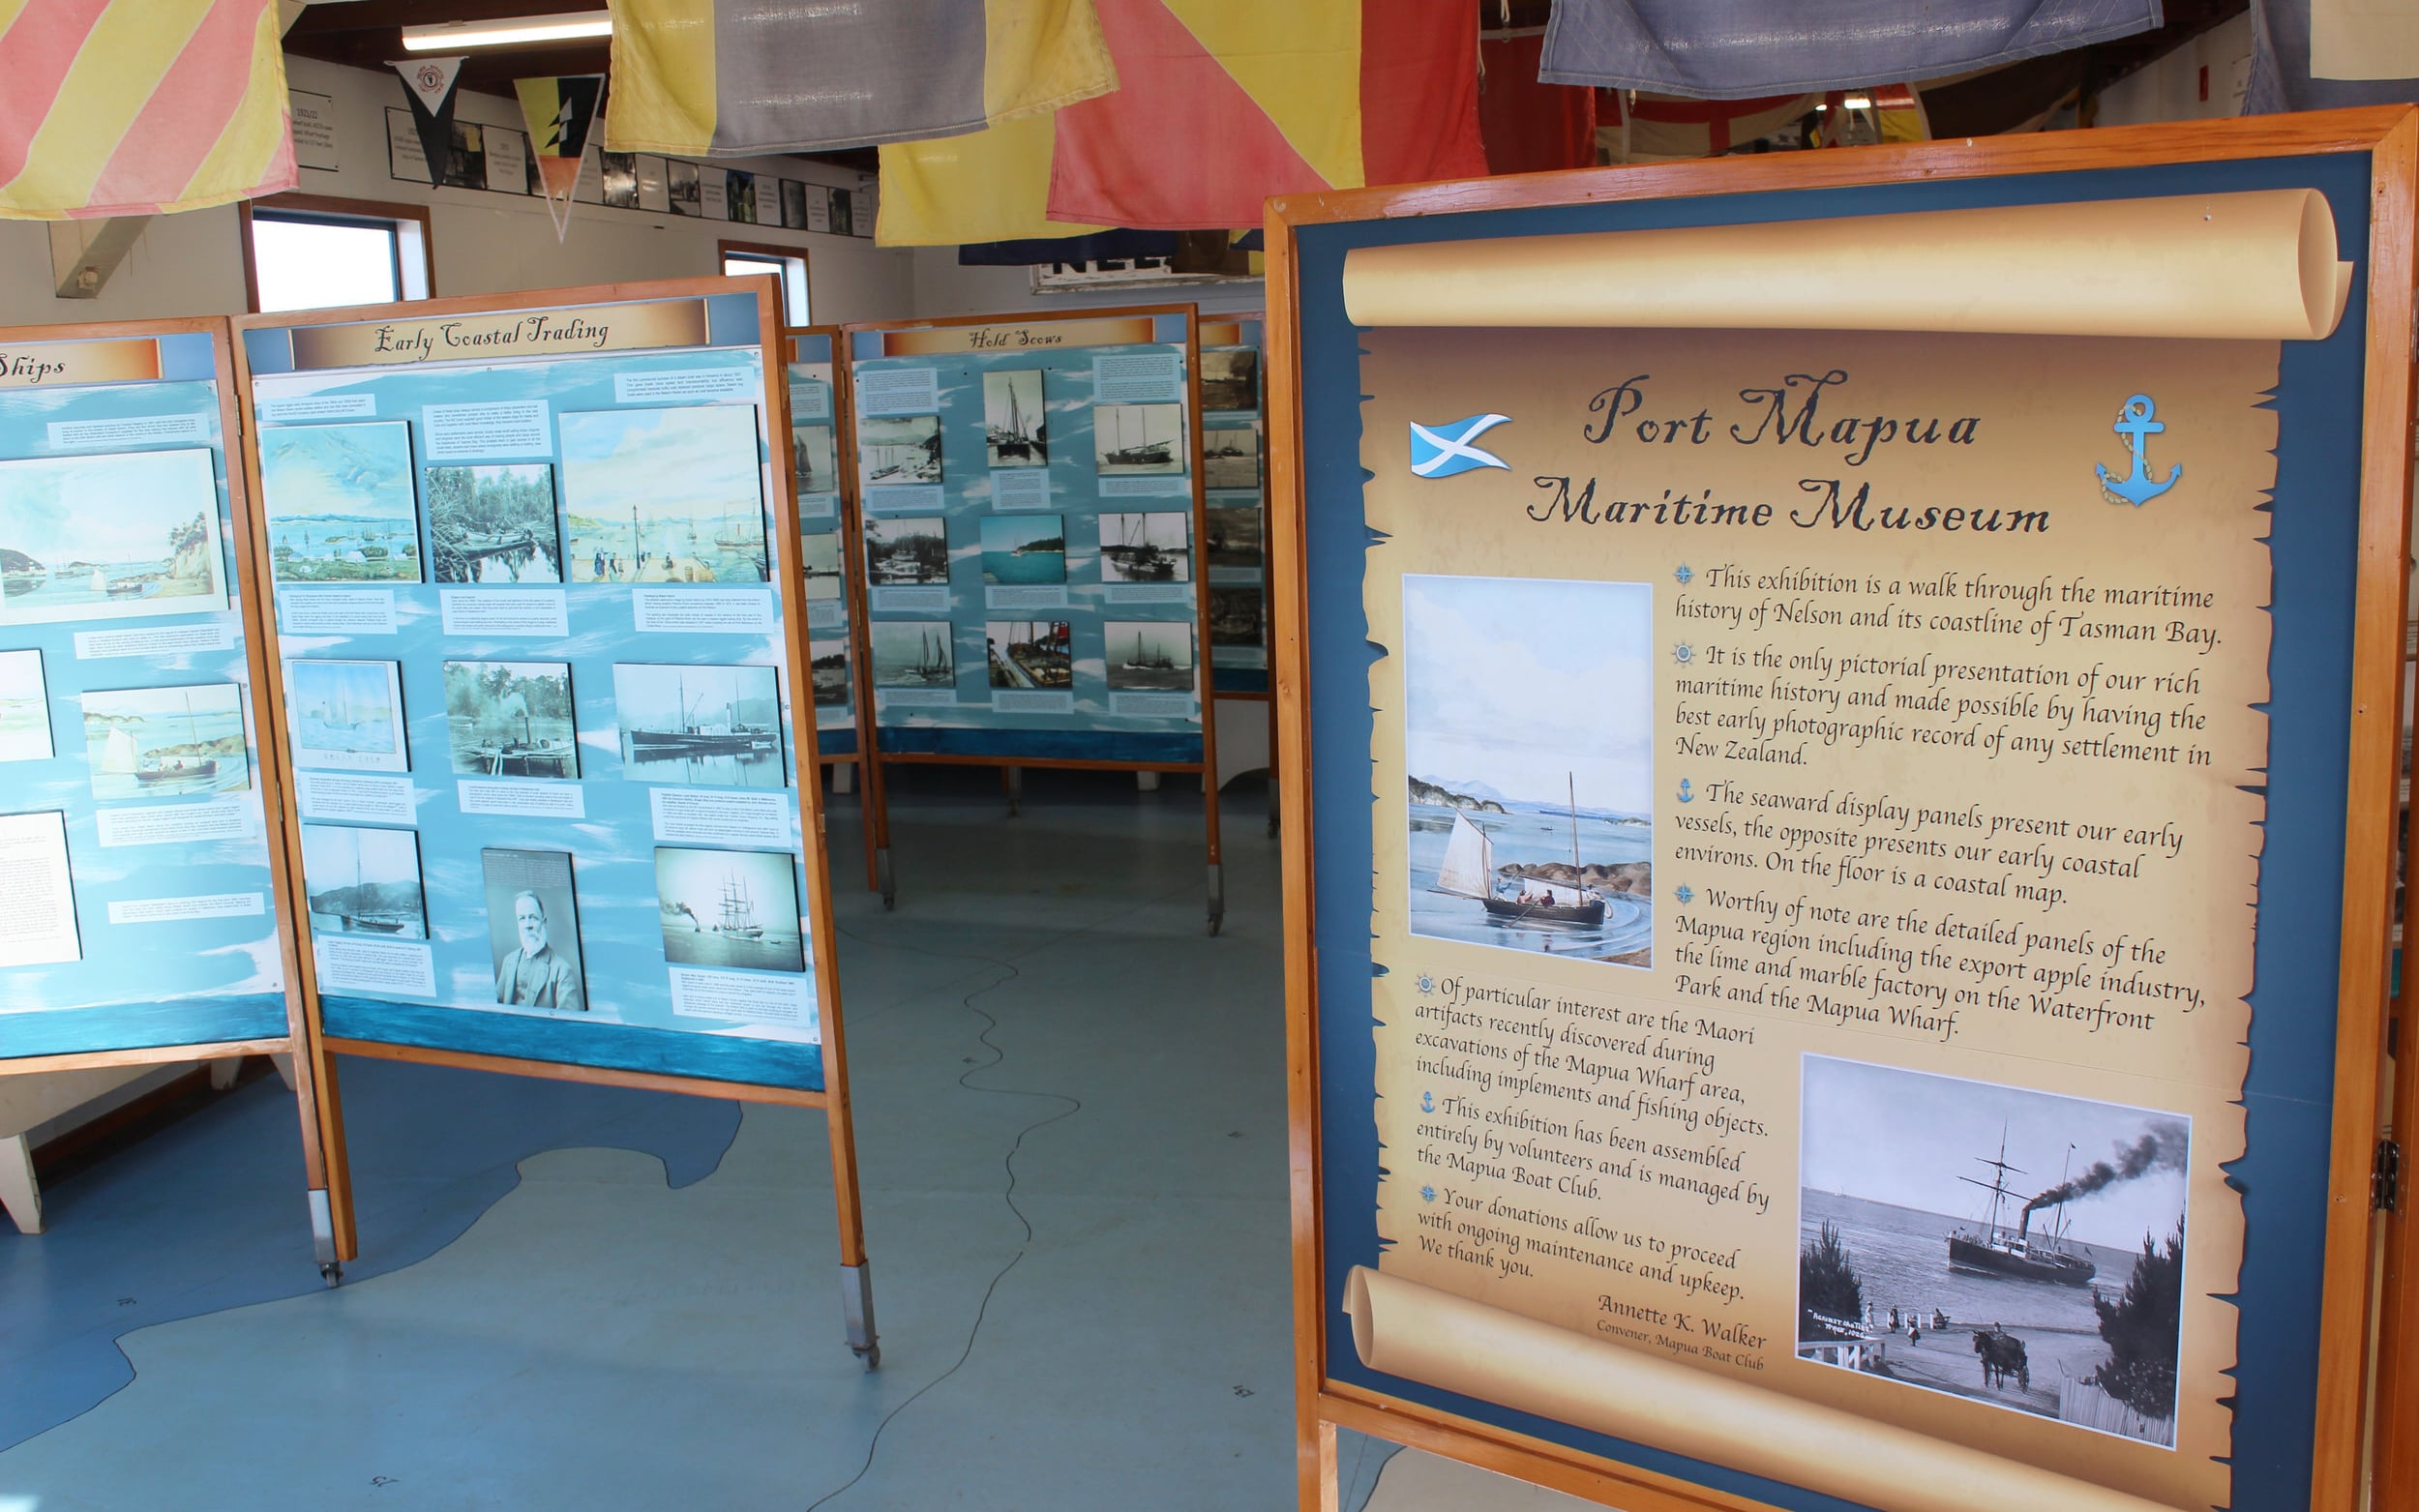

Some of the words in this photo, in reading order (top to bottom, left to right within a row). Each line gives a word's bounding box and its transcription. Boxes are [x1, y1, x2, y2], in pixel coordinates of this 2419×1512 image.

[374, 325, 433, 361] Early
[440, 321, 523, 347] Coastal
[526, 316, 610, 348] Trading
[969, 328, 1010, 348] Hold
[1015, 329, 1062, 346] Scows
[1584, 373, 1715, 445] Port
[1729, 370, 1982, 466] Mapua
[1526, 475, 1774, 526] Maritime
[1790, 478, 2050, 533] Museum
[1706, 563, 1751, 590] This
[1758, 566, 1859, 594] exhibition
[1866, 575, 1882, 595] is
[1888, 580, 1901, 596] a
[1908, 572, 1957, 599] walk
[1964, 574, 2053, 612] through
[2061, 577, 2096, 604] the
[2105, 585, 2214, 608] maritime
[1676, 594, 1743, 631] history
[1749, 600, 1769, 632] of
[1774, 597, 1844, 624] Nelson
[1850, 603, 1896, 629] and
[1897, 608, 1924, 630] its
[1929, 608, 2023, 636] coastline
[2030, 609, 2057, 647] of
[2059, 610, 2158, 642] Tasman
[2165, 621, 2222, 655] Bay.
[1706, 645, 1726, 665] It
[1732, 647, 1747, 666] is
[1753, 643, 1782, 668] the
[1789, 646, 1833, 682] only
[1834, 652, 1932, 689] pictorial
[1928, 665, 2069, 689] presentation
[2077, 662, 2104, 698] of
[2105, 674, 2147, 691] our
[2154, 667, 2200, 695] rich
[1676, 677, 1764, 698] maritime
[1771, 676, 1840, 714] history
[1847, 683, 1893, 707] and
[1895, 687, 1952, 713] made
[1952, 692, 2039, 724] possible
[2047, 694, 2075, 731] by
[2083, 697, 2162, 738] having
[2170, 702, 2206, 730] the
[1676, 700, 1712, 726] best
[1717, 706, 1768, 740] early
[1767, 709, 1904, 749] photographic
[1912, 723, 1983, 747] record
[1984, 725, 2009, 759] of
[2011, 736, 2054, 764] any
[2061, 732, 2180, 763] settlement
[2188, 744, 2211, 766] in
[1676, 732, 1718, 756] New
[1724, 737, 1808, 765] Zealand.
[1675, 811, 1737, 838] vessels,
[1744, 815, 1774, 839] the
[1779, 827, 1860, 858] opposite
[1861, 833, 1948, 860] presents
[1955, 845, 1992, 862] our
[1998, 844, 2054, 879] early
[2062, 853, 2146, 878] coastal
[1706, 780, 1745, 806] The
[1750, 789, 1836, 815] seaward
[1836, 791, 1911, 829] display
[1911, 803, 1984, 834] panels
[1985, 816, 2070, 842] present
[2076, 822, 2118, 842] our
[2124, 821, 2184, 859] early
[1675, 845, 1758, 868] environs.
[1766, 847, 1794, 873] On
[1802, 851, 1833, 878] the
[1832, 855, 1885, 888] floor
[1893, 866, 1907, 885] is
[1914, 874, 1926, 888] a
[1934, 873, 2013, 897] coastal
[2015, 885, 2067, 913] map.
[1706, 888, 1778, 924] Worthy
[1785, 895, 1807, 928] of
[1810, 906, 1851, 924] note
[1858, 913, 1890, 930] are
[1896, 908, 1928, 934] the
[1935, 913, 2024, 947] detailed
[2022, 930, 2096, 959] panels
[2103, 934, 2129, 969] of
[2131, 937, 2165, 964] the
[1675, 915, 1745, 943] Mapua
[1752, 929, 1810, 956] region
[1819, 934, 1913, 974] including
[1921, 945, 1953, 970] the
[1959, 958, 2027, 984] export
[2034, 963, 2091, 995] apple
[2100, 970, 2205, 1013] industry,
[1416, 1002, 1482, 1028] artifacts
[1489, 1018, 1555, 1047] recently
[1561, 1023, 1652, 1056] discovered
[1653, 1038, 1715, 1077] during
[1675, 975, 1722, 998] Park
[1727, 983, 1769, 1005] and
[1768, 983, 1800, 1010] the
[1807, 994, 1879, 1026] Mapua
[1888, 1005, 1959, 1043] Wharf.
[1416, 1027, 1508, 1060] excavations
[1513, 1043, 1533, 1070] of
[1535, 1045, 1560, 1069] the
[1566, 1055, 1628, 1082] Mapua
[1636, 1066, 1699, 1100] Wharf
[1700, 1083, 1745, 1106] area,
[1418, 1055, 1492, 1093] including
[1499, 1069, 1593, 1103] implements
[1598, 1090, 1636, 1111] and
[1632, 1092, 1699, 1133] fishing
[1705, 1107, 1768, 1139] objects.
[1417, 1120, 1479, 1152] entirely
[1484, 1129, 1504, 1157] by
[1508, 1138, 1593, 1171] volunteers
[1598, 1158, 1637, 1179] and
[1639, 1165, 1652, 1183] is
[1659, 1173, 1746, 1205] managed
[1747, 1183, 1770, 1215] by
[1442, 1095, 1479, 1120] This
[1485, 1106, 1568, 1138] exhibition
[1574, 1119, 1602, 1144] has
[1609, 1126, 1646, 1153] been
[1653, 1144, 1747, 1172] assembled
[1418, 1143, 1441, 1166] the
[1447, 1151, 1506, 1180] Mapua
[1511, 1167, 1553, 1190] Boat
[1558, 1174, 1601, 1201] Club.
[1418, 1211, 1451, 1231] with
[1457, 1223, 1520, 1256] ongoing
[1527, 1238, 1633, 1274] maintenance
[1639, 1260, 1678, 1283] and
[1681, 1274, 1744, 1306] upkeep.
[1419, 1235, 1443, 1255] We
[1448, 1240, 1495, 1268] thank
[1499, 1260, 1534, 1279] you.
[1444, 1188, 1483, 1211] Your
[1488, 1196, 1568, 1231] donations
[1573, 1216, 1618, 1241] allow
[1624, 1233, 1642, 1248] us
[1649, 1236, 1665, 1253] to
[1671, 1244, 1742, 1274] proceed
[1597, 1320, 1651, 1344] Convener,
[1656, 1334, 1698, 1355] Mapua
[1702, 1347, 1730, 1362] Boat
[1736, 1354, 1764, 1371] Club
[1598, 1294, 1667, 1325] Annette
[1673, 1313, 1694, 1332] K.
[1702, 1319, 1767, 1349] Walker
